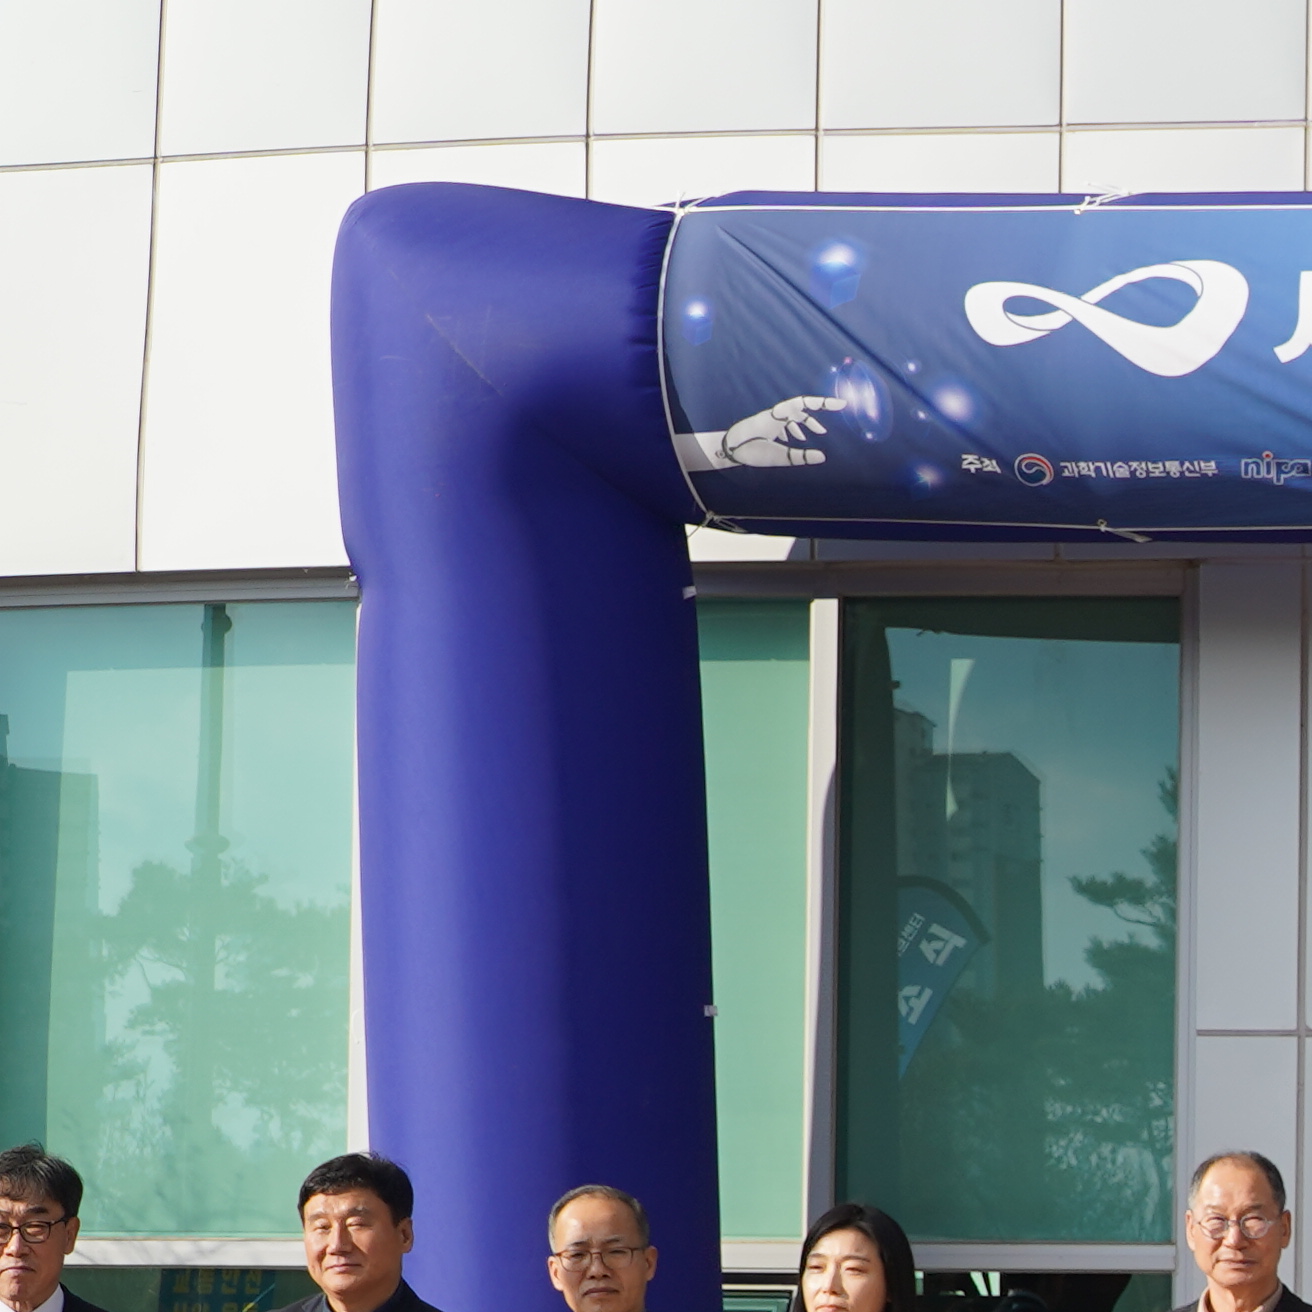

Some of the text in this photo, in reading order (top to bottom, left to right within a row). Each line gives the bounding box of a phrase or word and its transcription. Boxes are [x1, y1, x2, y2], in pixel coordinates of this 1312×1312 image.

[961, 454, 1001, 474] 주최
[1060, 460, 1218, 478] 과학기술정보통신부
[1241, 451, 1311, 485] nipa
